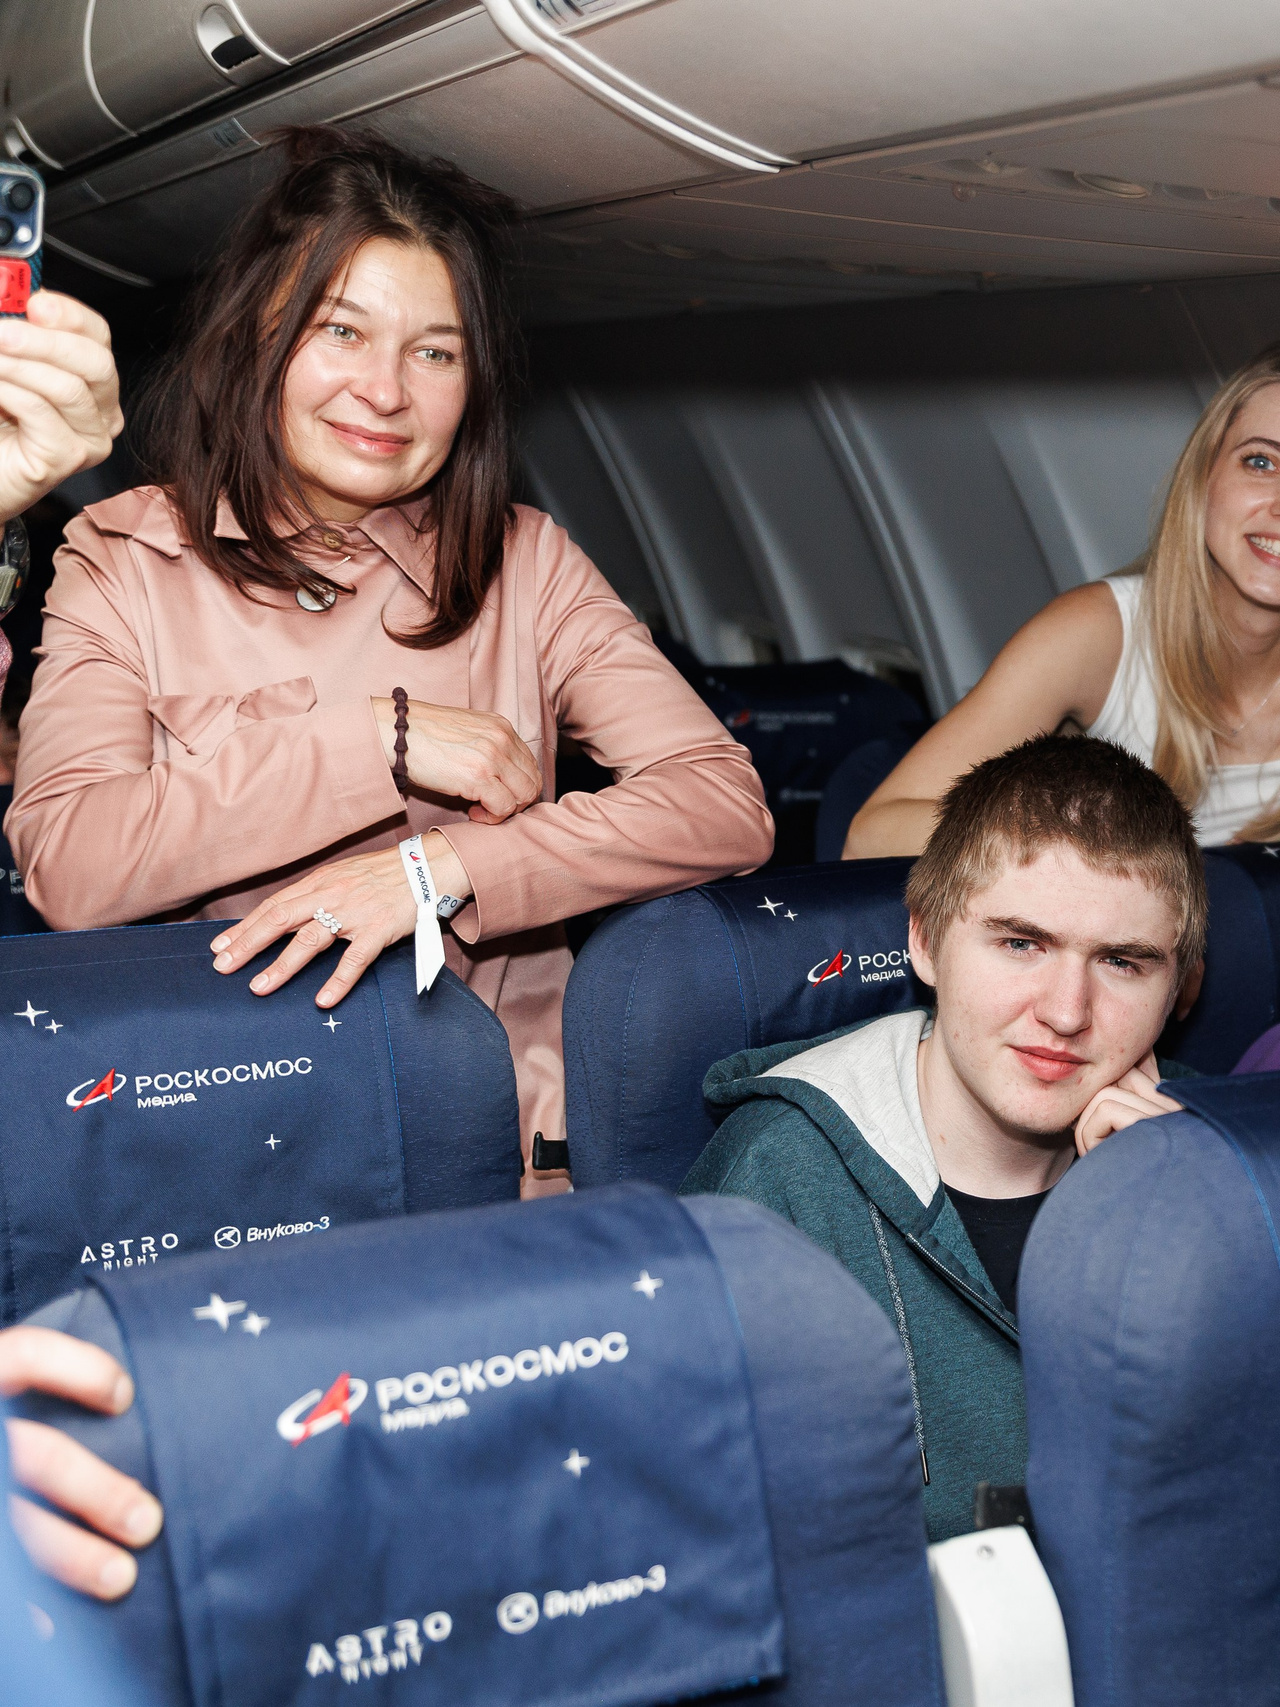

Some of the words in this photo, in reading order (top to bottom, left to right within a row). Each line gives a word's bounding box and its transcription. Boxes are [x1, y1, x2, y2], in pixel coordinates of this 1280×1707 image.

[860, 969, 906, 983] медиа
[135, 1057, 313, 1094] РОСКОСМОС
[137, 1092, 198, 1109] медиа
[246, 1216, 331, 1243] Внуково-3
[80, 1232, 180, 1264] ASTRO
[102, 1252, 159, 1271] NIGHT
[375, 1331, 629, 1412] РОСКОСМОС
[305, 1610, 453, 1678] ASTRO
